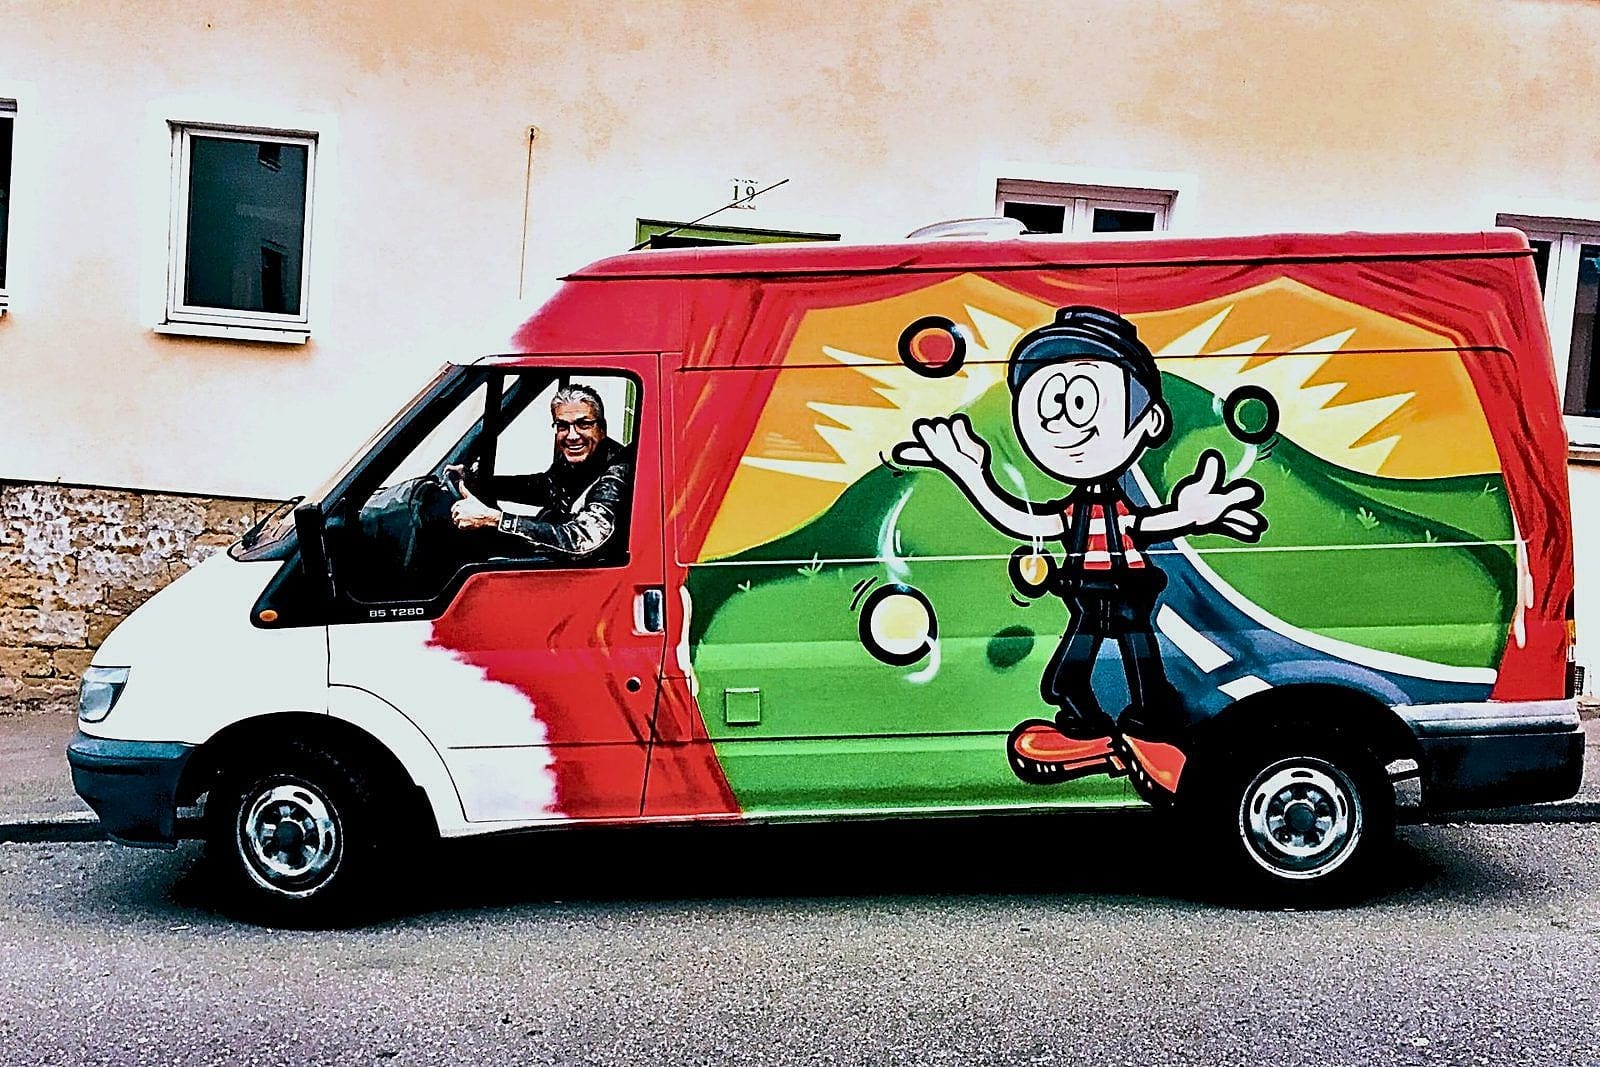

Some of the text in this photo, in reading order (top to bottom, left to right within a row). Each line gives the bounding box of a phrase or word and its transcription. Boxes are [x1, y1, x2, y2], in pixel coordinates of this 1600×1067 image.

[732, 185, 756, 202] 19
[369, 607, 424, 617] 85 T280
